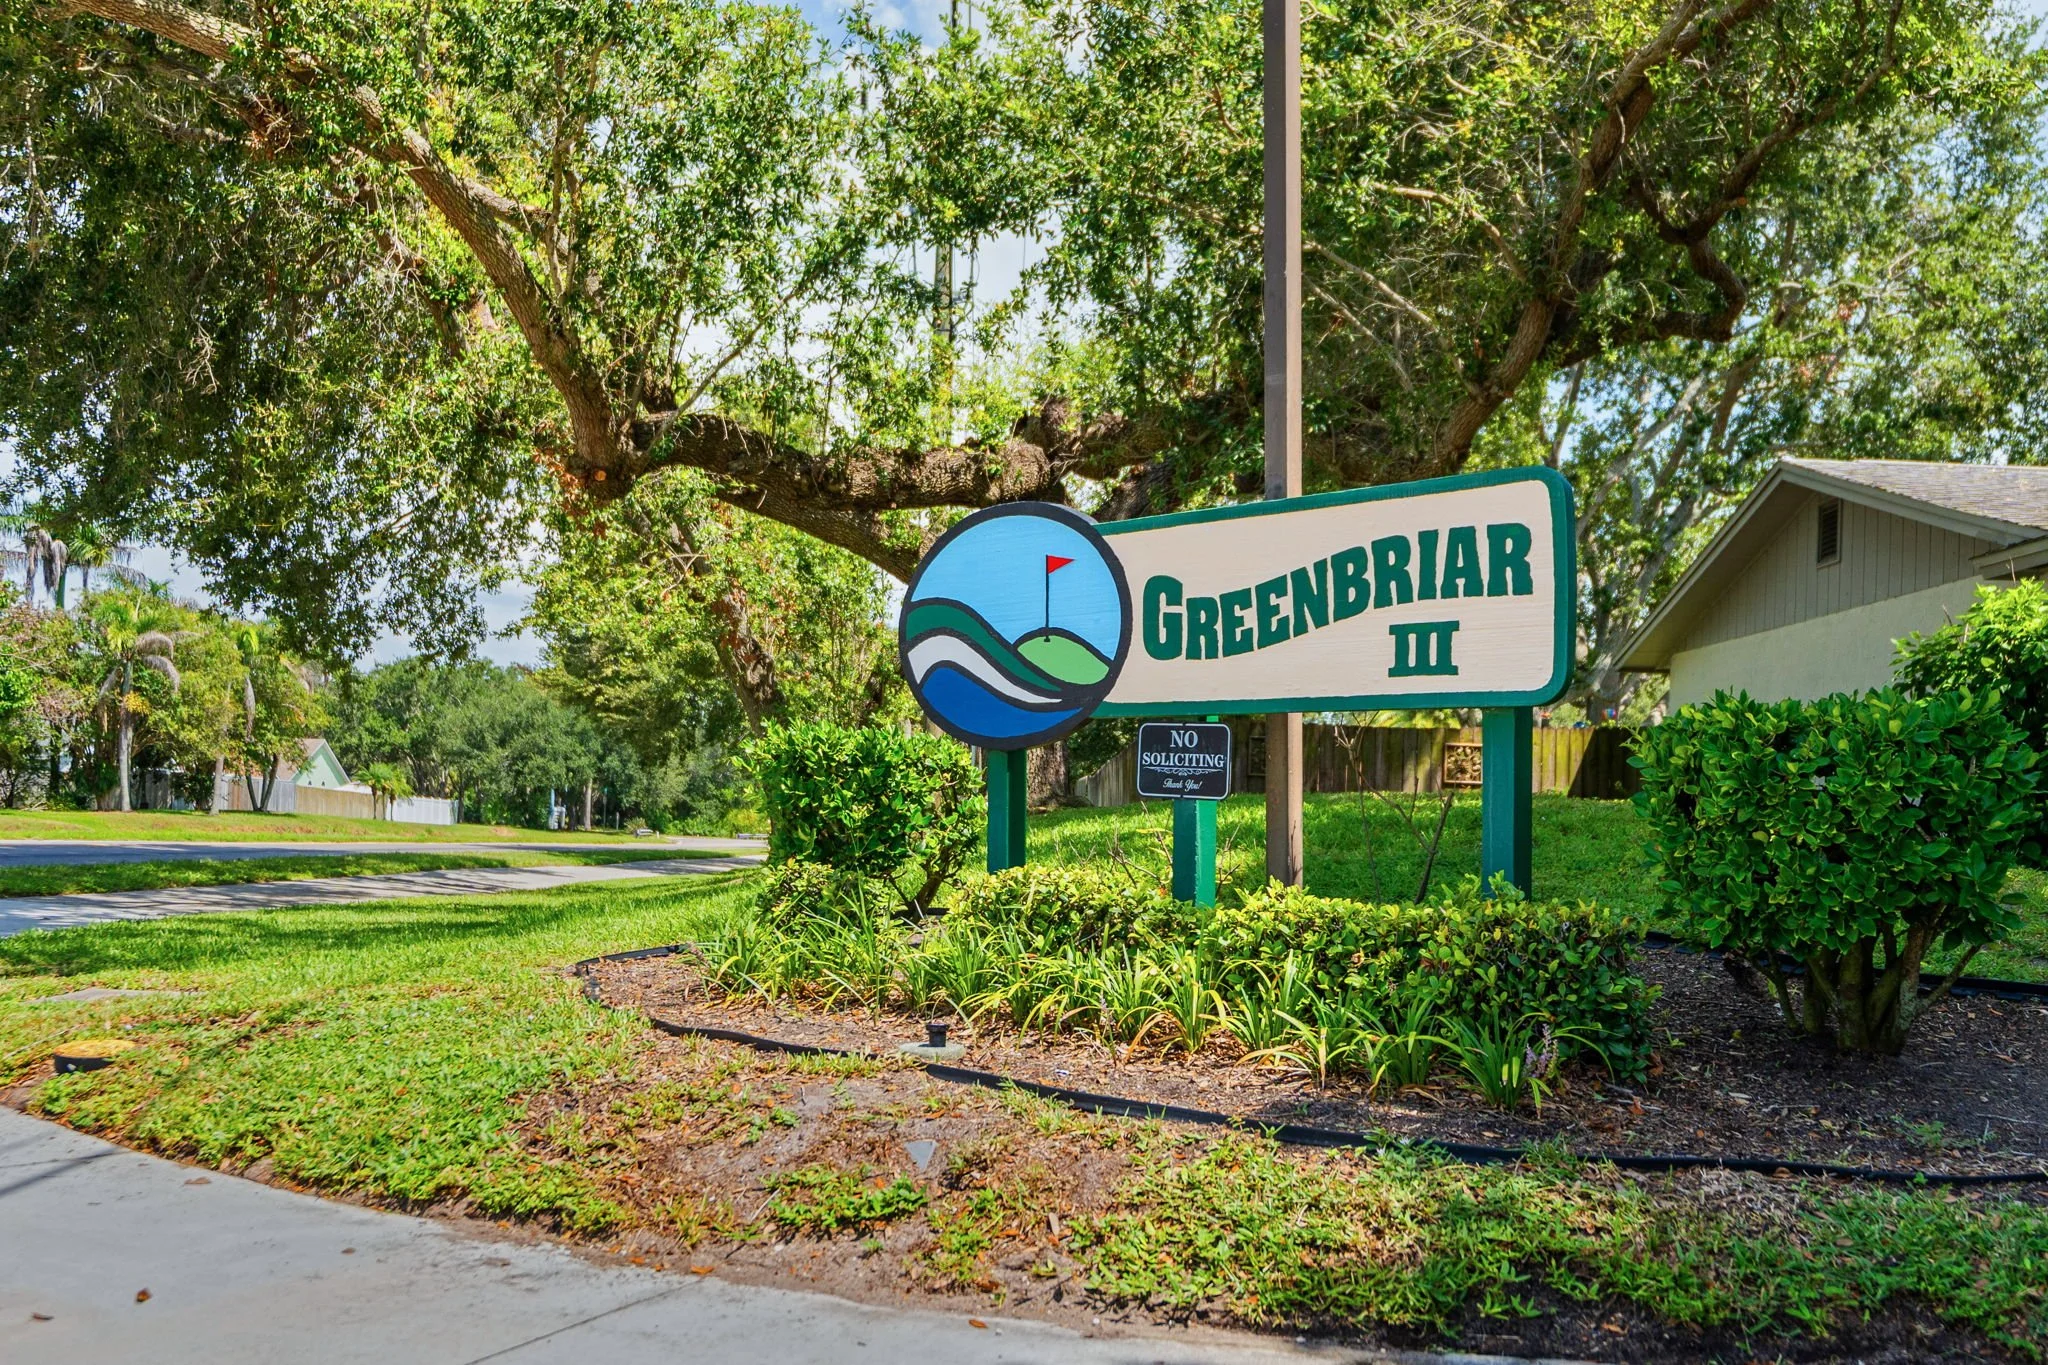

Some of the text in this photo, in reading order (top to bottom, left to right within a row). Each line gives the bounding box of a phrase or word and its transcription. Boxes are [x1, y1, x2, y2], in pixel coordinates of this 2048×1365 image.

[1142, 522, 1534, 661] GREENBRIAR
[1387, 620, 1460, 678] III
[1169, 730, 1199, 748] NO
[1142, 752, 1225, 768] SOLICITING
[1162, 778, 1203, 792] Thank You!
